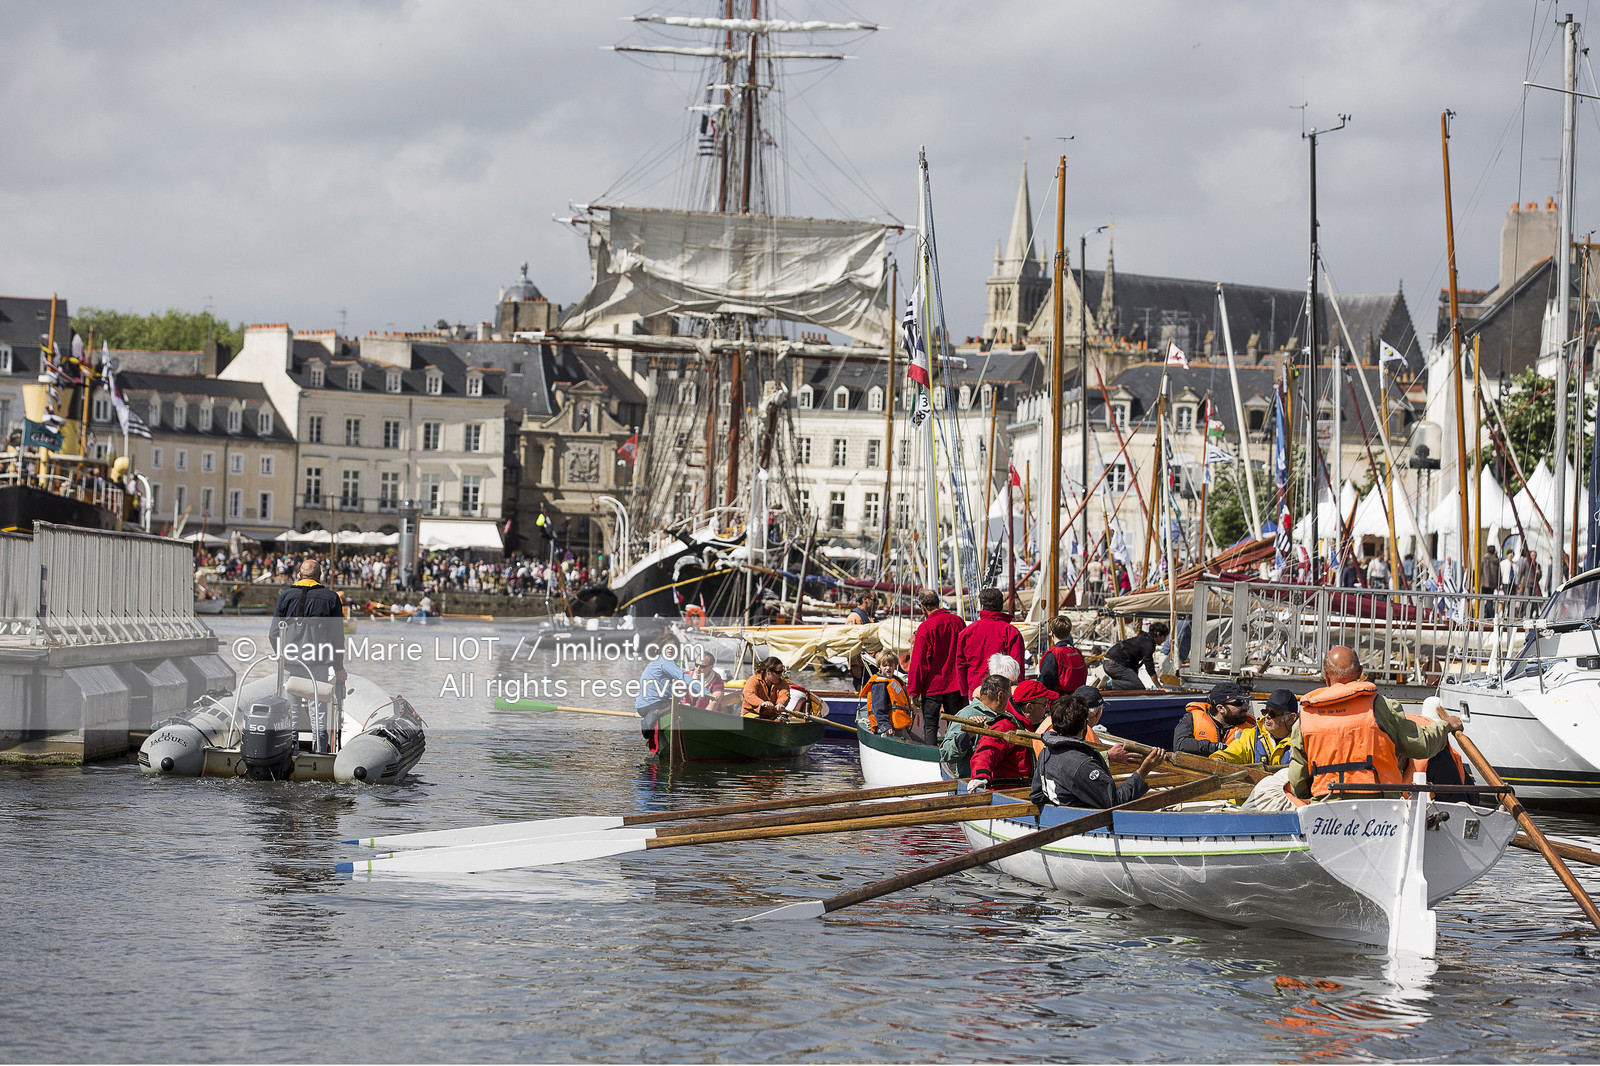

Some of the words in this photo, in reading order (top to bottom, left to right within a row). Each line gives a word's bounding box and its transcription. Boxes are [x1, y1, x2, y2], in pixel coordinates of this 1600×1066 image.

[249, 723, 266, 732] 50
[149, 735, 189, 748] JACQUES
[1312, 816, 1342, 836] Fille
[1343, 818, 1360, 836] de
[1361, 818, 1398, 837] Loire
